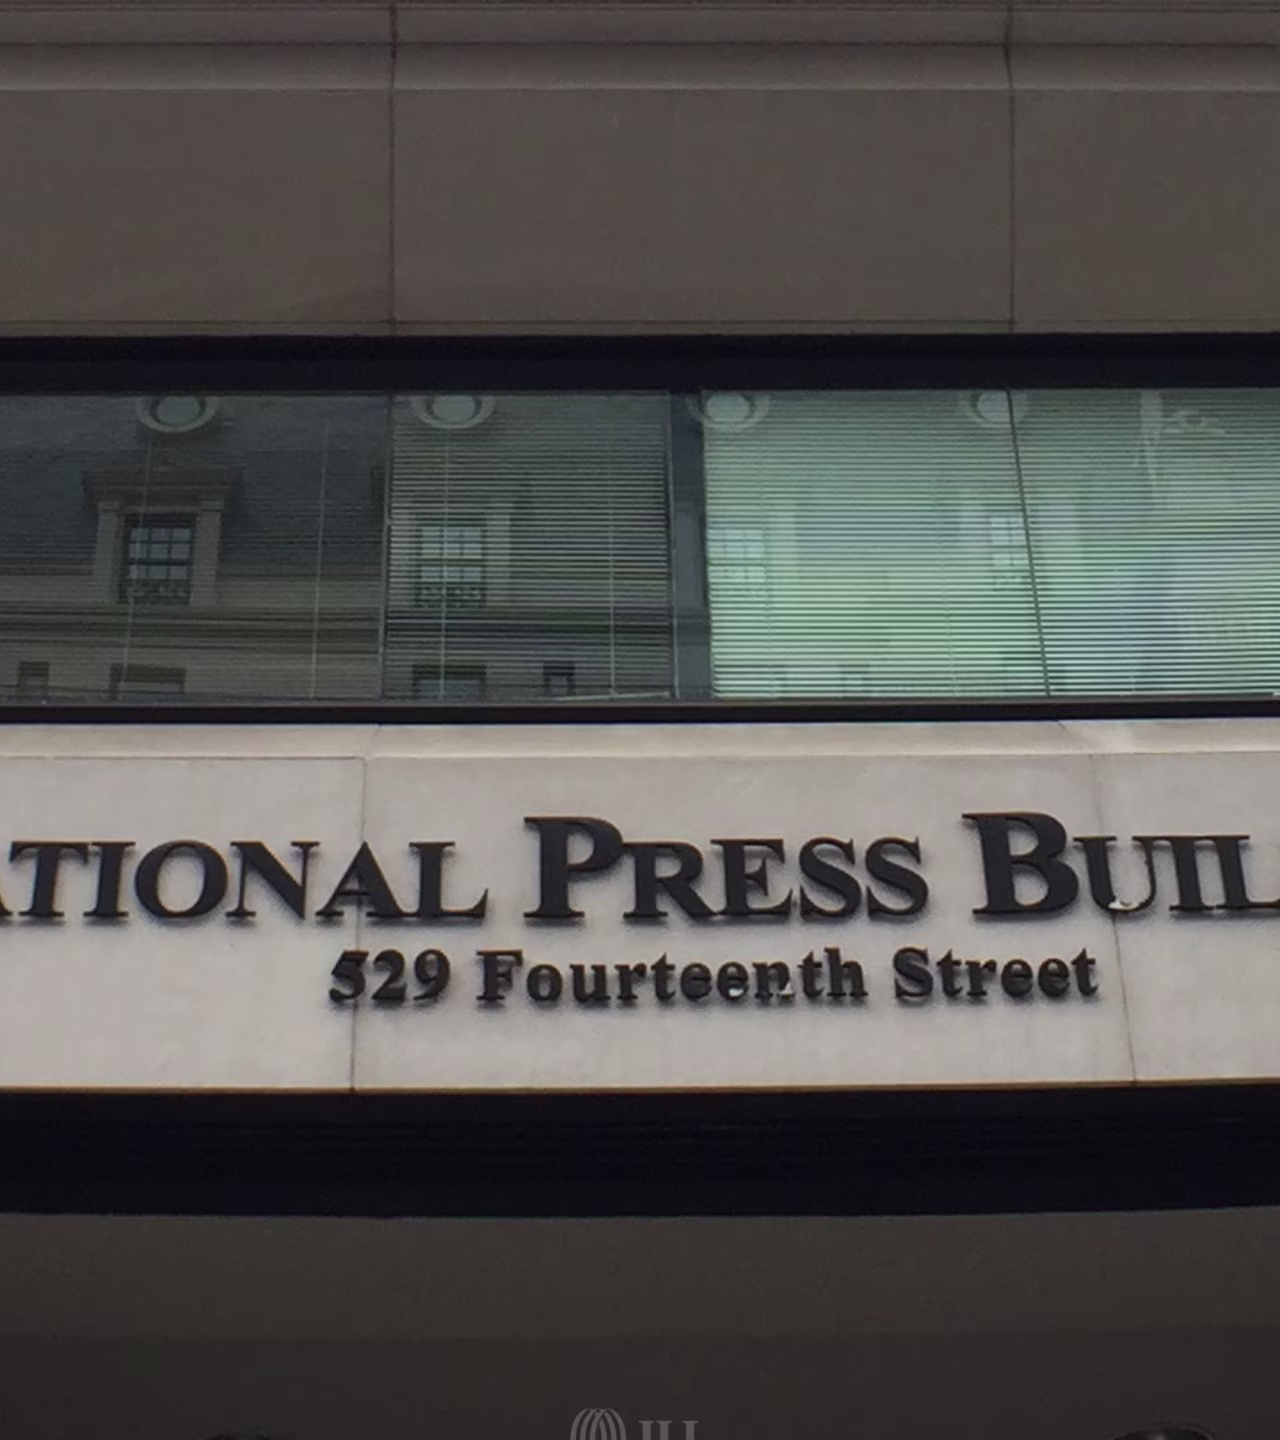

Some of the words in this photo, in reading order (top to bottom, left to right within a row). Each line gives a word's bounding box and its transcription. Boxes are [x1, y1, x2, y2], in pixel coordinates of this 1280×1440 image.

[523, 816, 930, 919] PRESS
[329, 949, 450, 1001] 529
[476, 948, 869, 1001] Fourteenth
[893, 947, 1098, 998] Street
